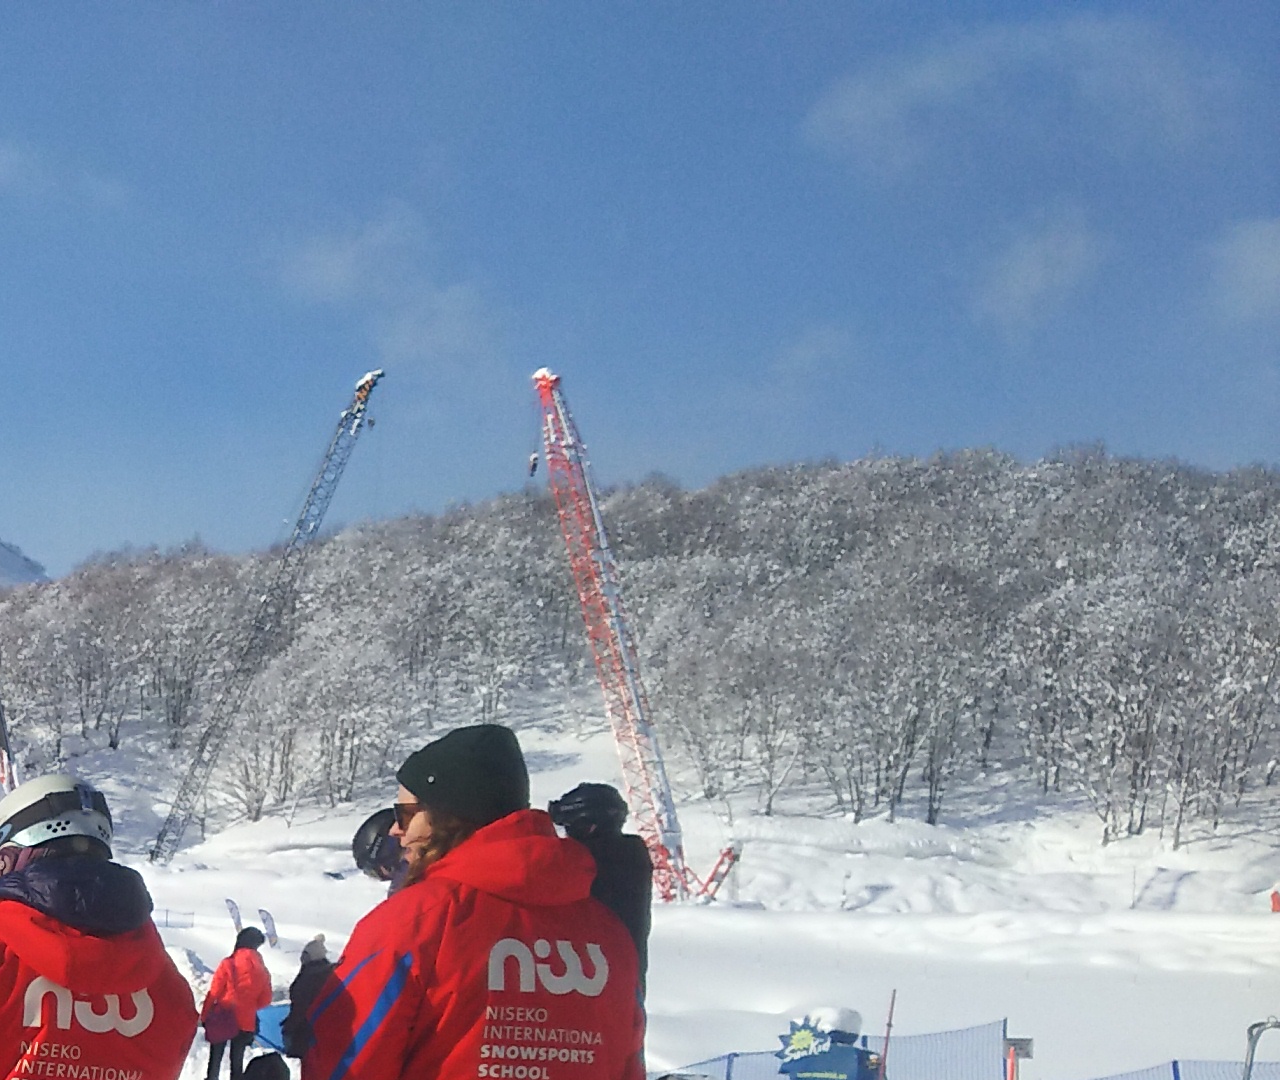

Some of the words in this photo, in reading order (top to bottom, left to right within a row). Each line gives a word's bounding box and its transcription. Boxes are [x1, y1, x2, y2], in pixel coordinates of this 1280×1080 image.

[485, 1005, 548, 1023] NISEKO
[483, 1025, 603, 1045] INTERNATIONA
[20, 1040, 81, 1060] NISEKO
[480, 1044, 595, 1064] SNOWSPORTS
[477, 1063, 550, 1080] SCHOOL
